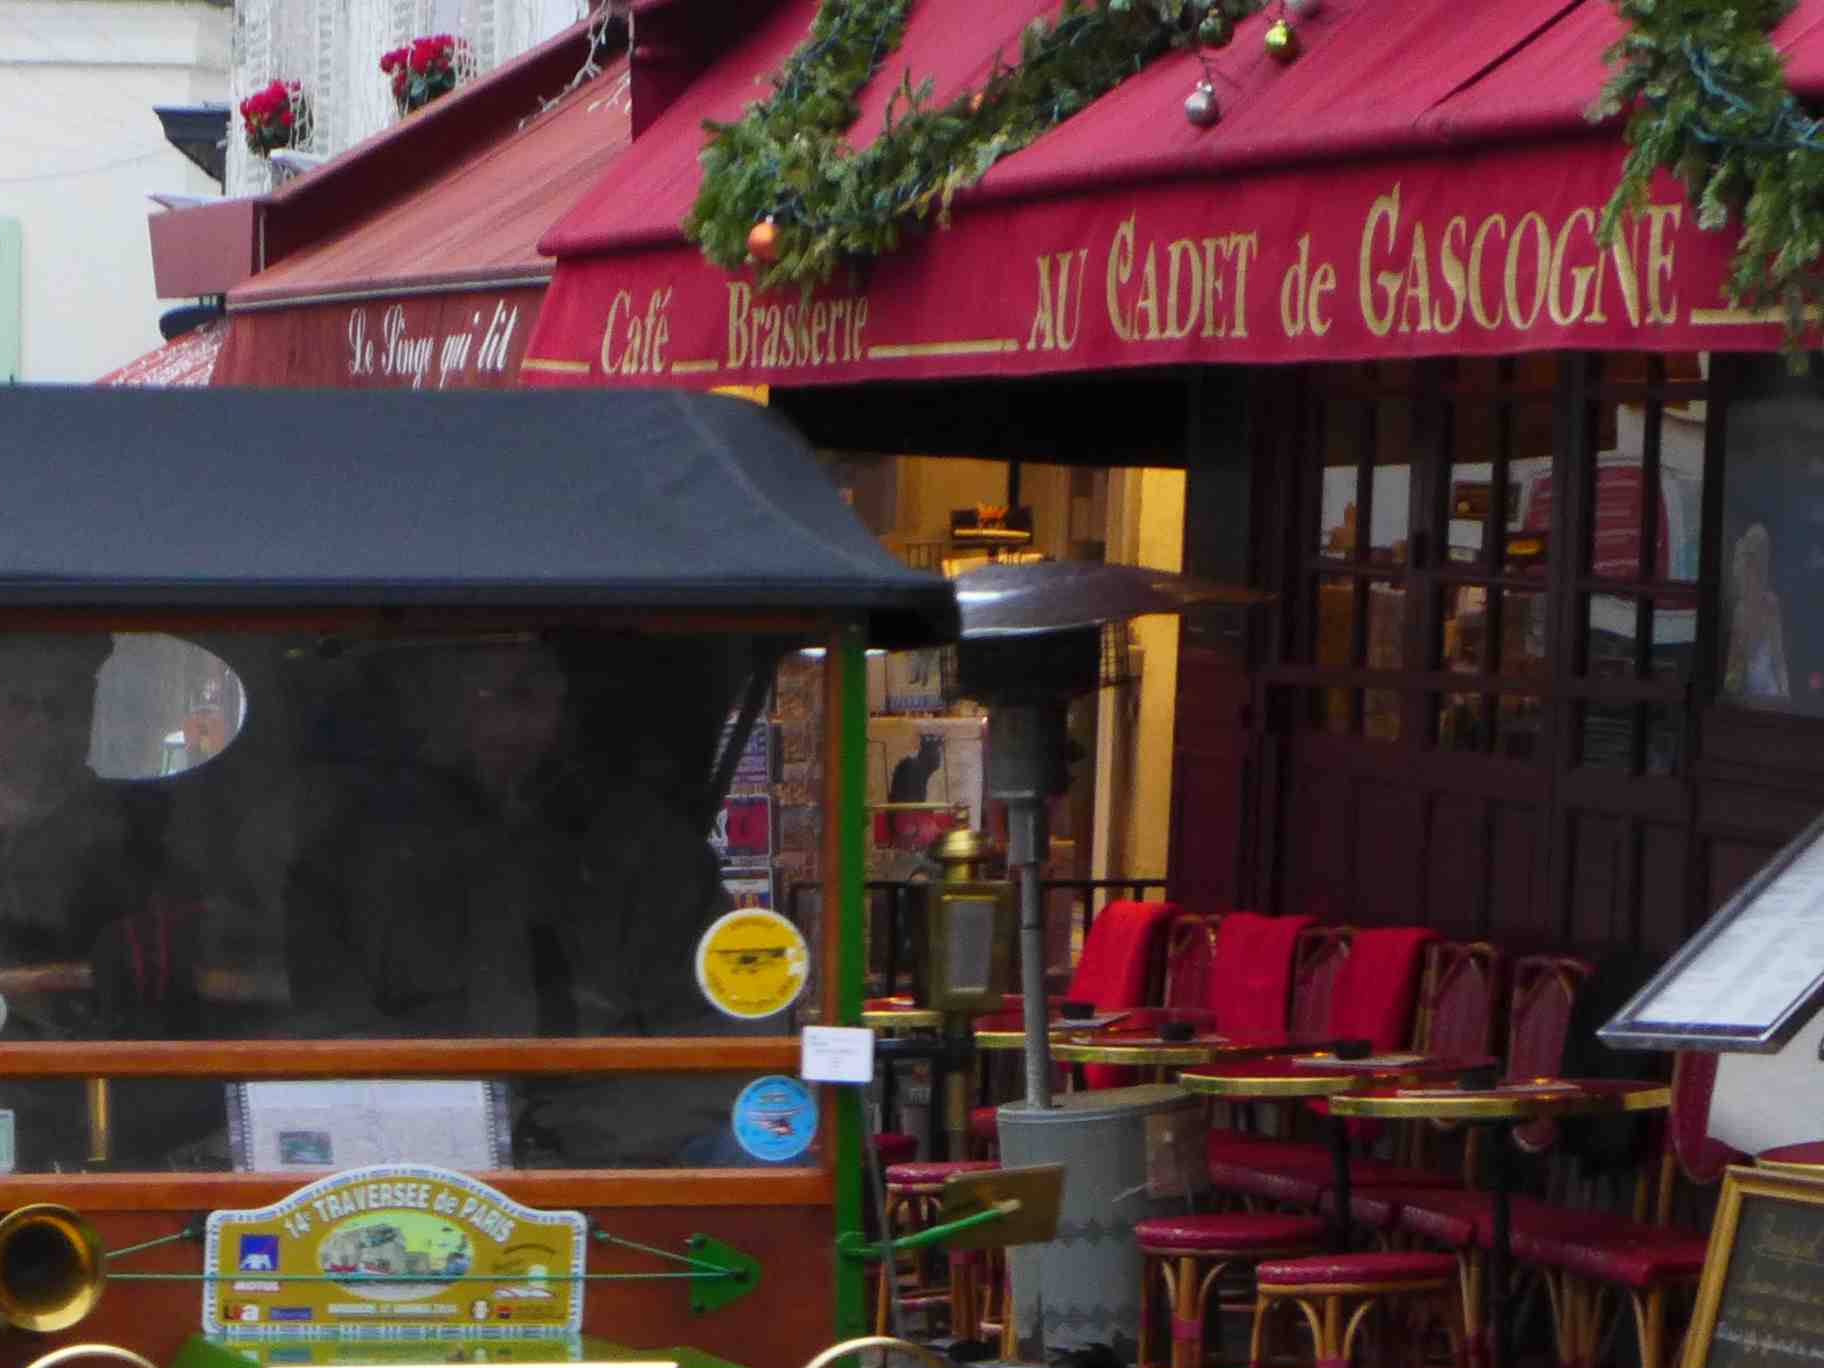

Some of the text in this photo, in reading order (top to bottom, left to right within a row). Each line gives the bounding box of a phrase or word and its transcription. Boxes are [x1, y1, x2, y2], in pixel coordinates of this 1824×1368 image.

[1027, 180, 1681, 351] AU CADET de GASCOGNE
[348, 307, 375, 376] Le
[439, 311, 480, 391] qui
[477, 299, 518, 370] lit
[601, 281, 868, 375] Café Brasserie
[433, 1188, 460, 1215] de
[458, 1197, 516, 1243] PARIS
